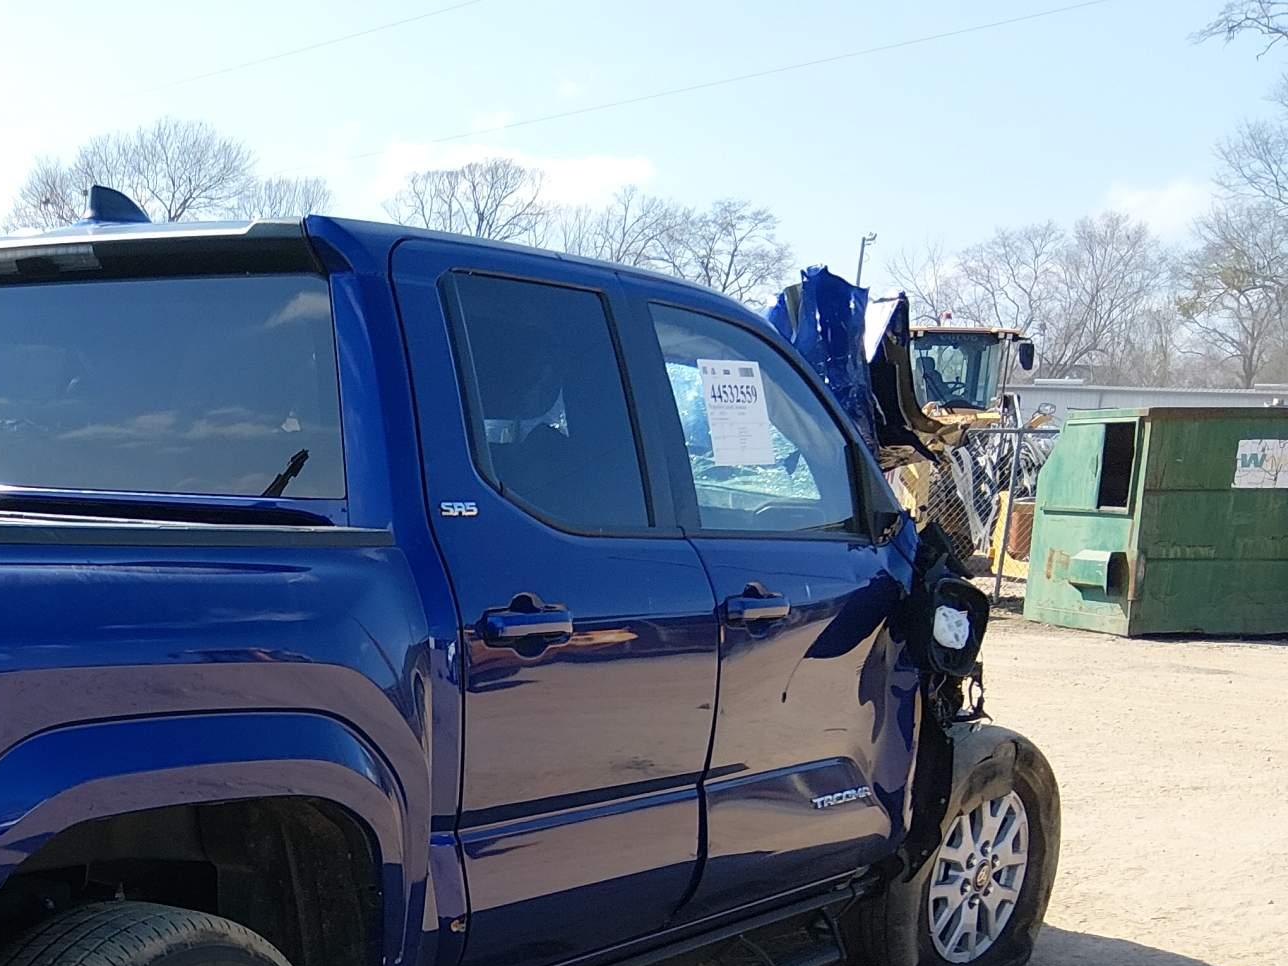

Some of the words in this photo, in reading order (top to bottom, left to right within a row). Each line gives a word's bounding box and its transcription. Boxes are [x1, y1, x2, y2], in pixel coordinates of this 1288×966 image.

[711, 384, 758, 404] 44532559
[441, 502, 477, 516] SR5
[812, 786, 872, 809] TACOMA
